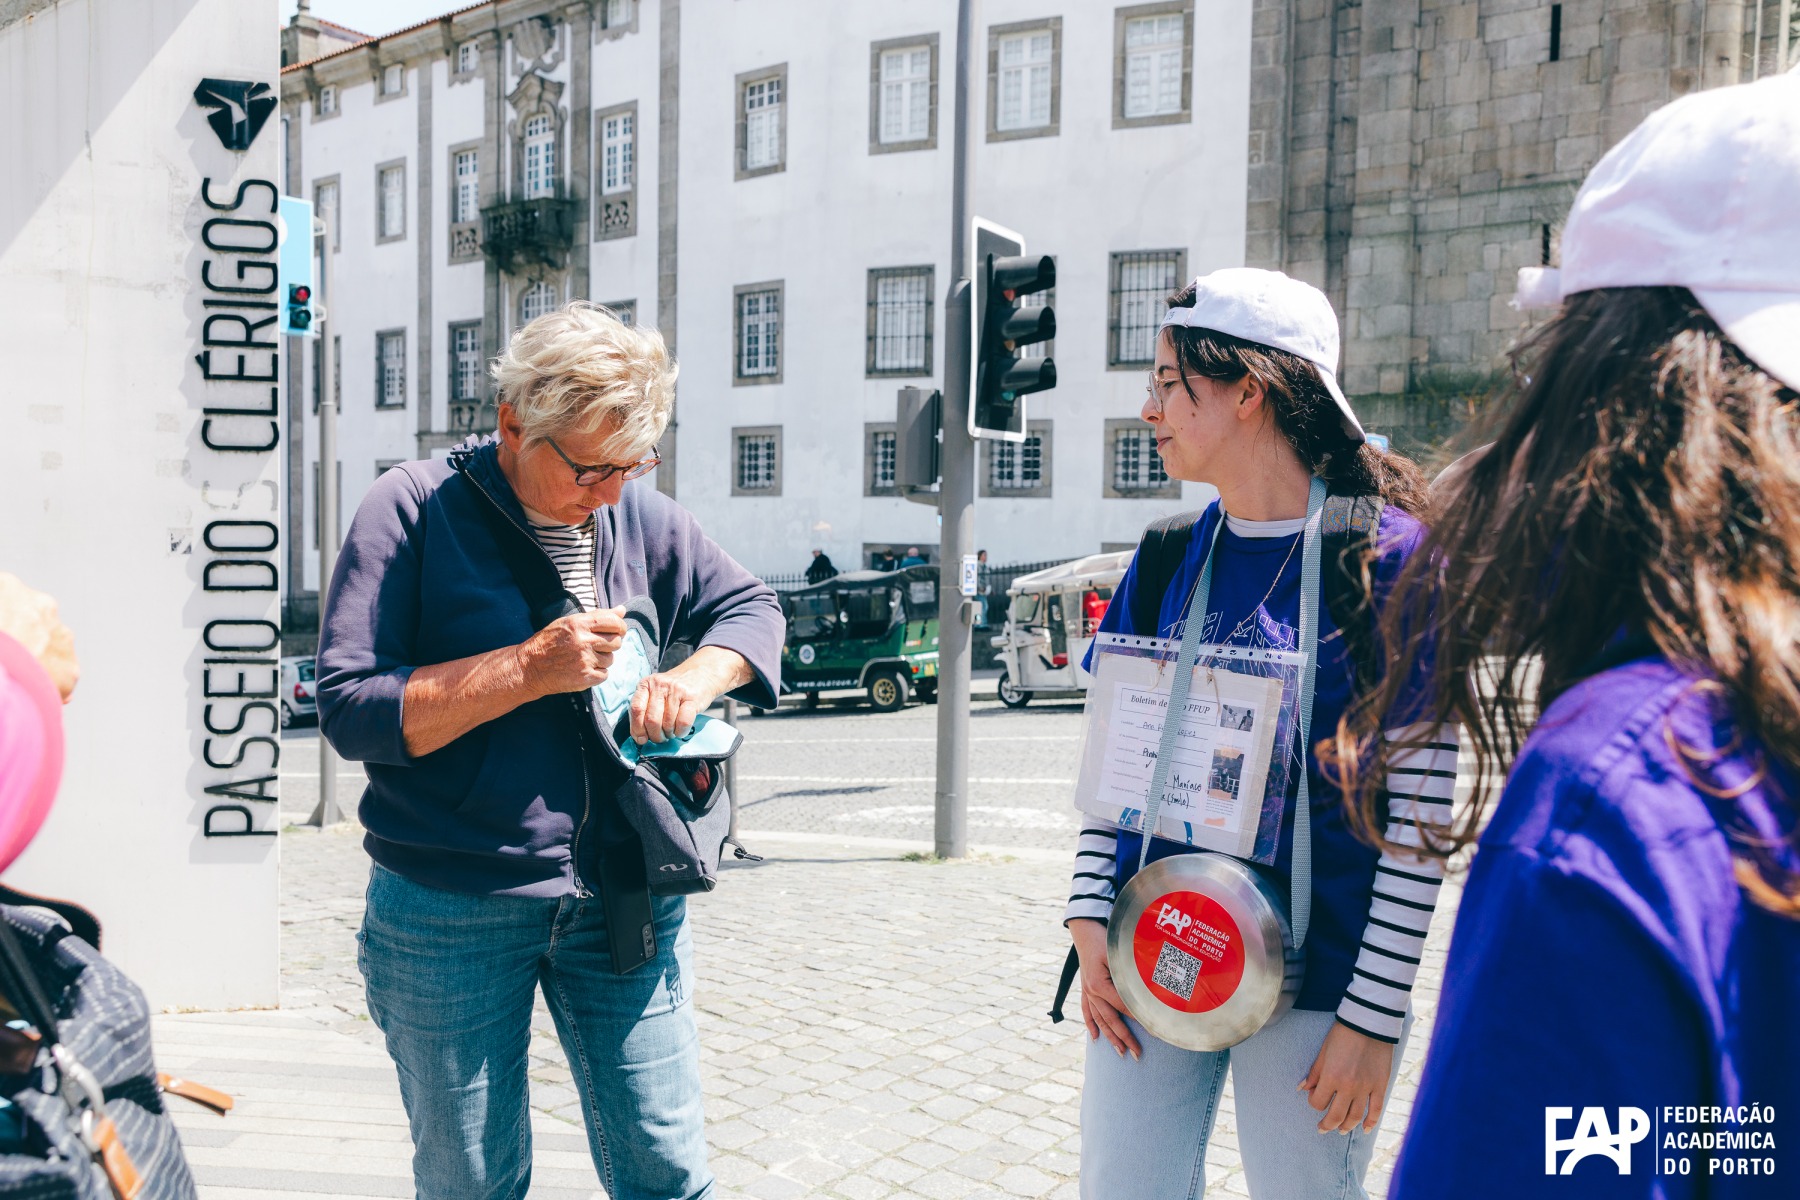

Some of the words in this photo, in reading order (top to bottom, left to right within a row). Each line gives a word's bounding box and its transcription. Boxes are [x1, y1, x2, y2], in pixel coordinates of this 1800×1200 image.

[194, 177, 280, 452] CLÉRIGOS
[1130, 694, 1157, 706] Boletim
[1187, 703, 1211, 714] FFUP
[203, 619, 280, 837] PASSEIO
[1156, 902, 1192, 936] FAP
[1194, 919, 1230, 942] FEDERAÇÃO
[1188, 935, 1199, 945] DO
[1201, 942, 1224, 958] PORTO
